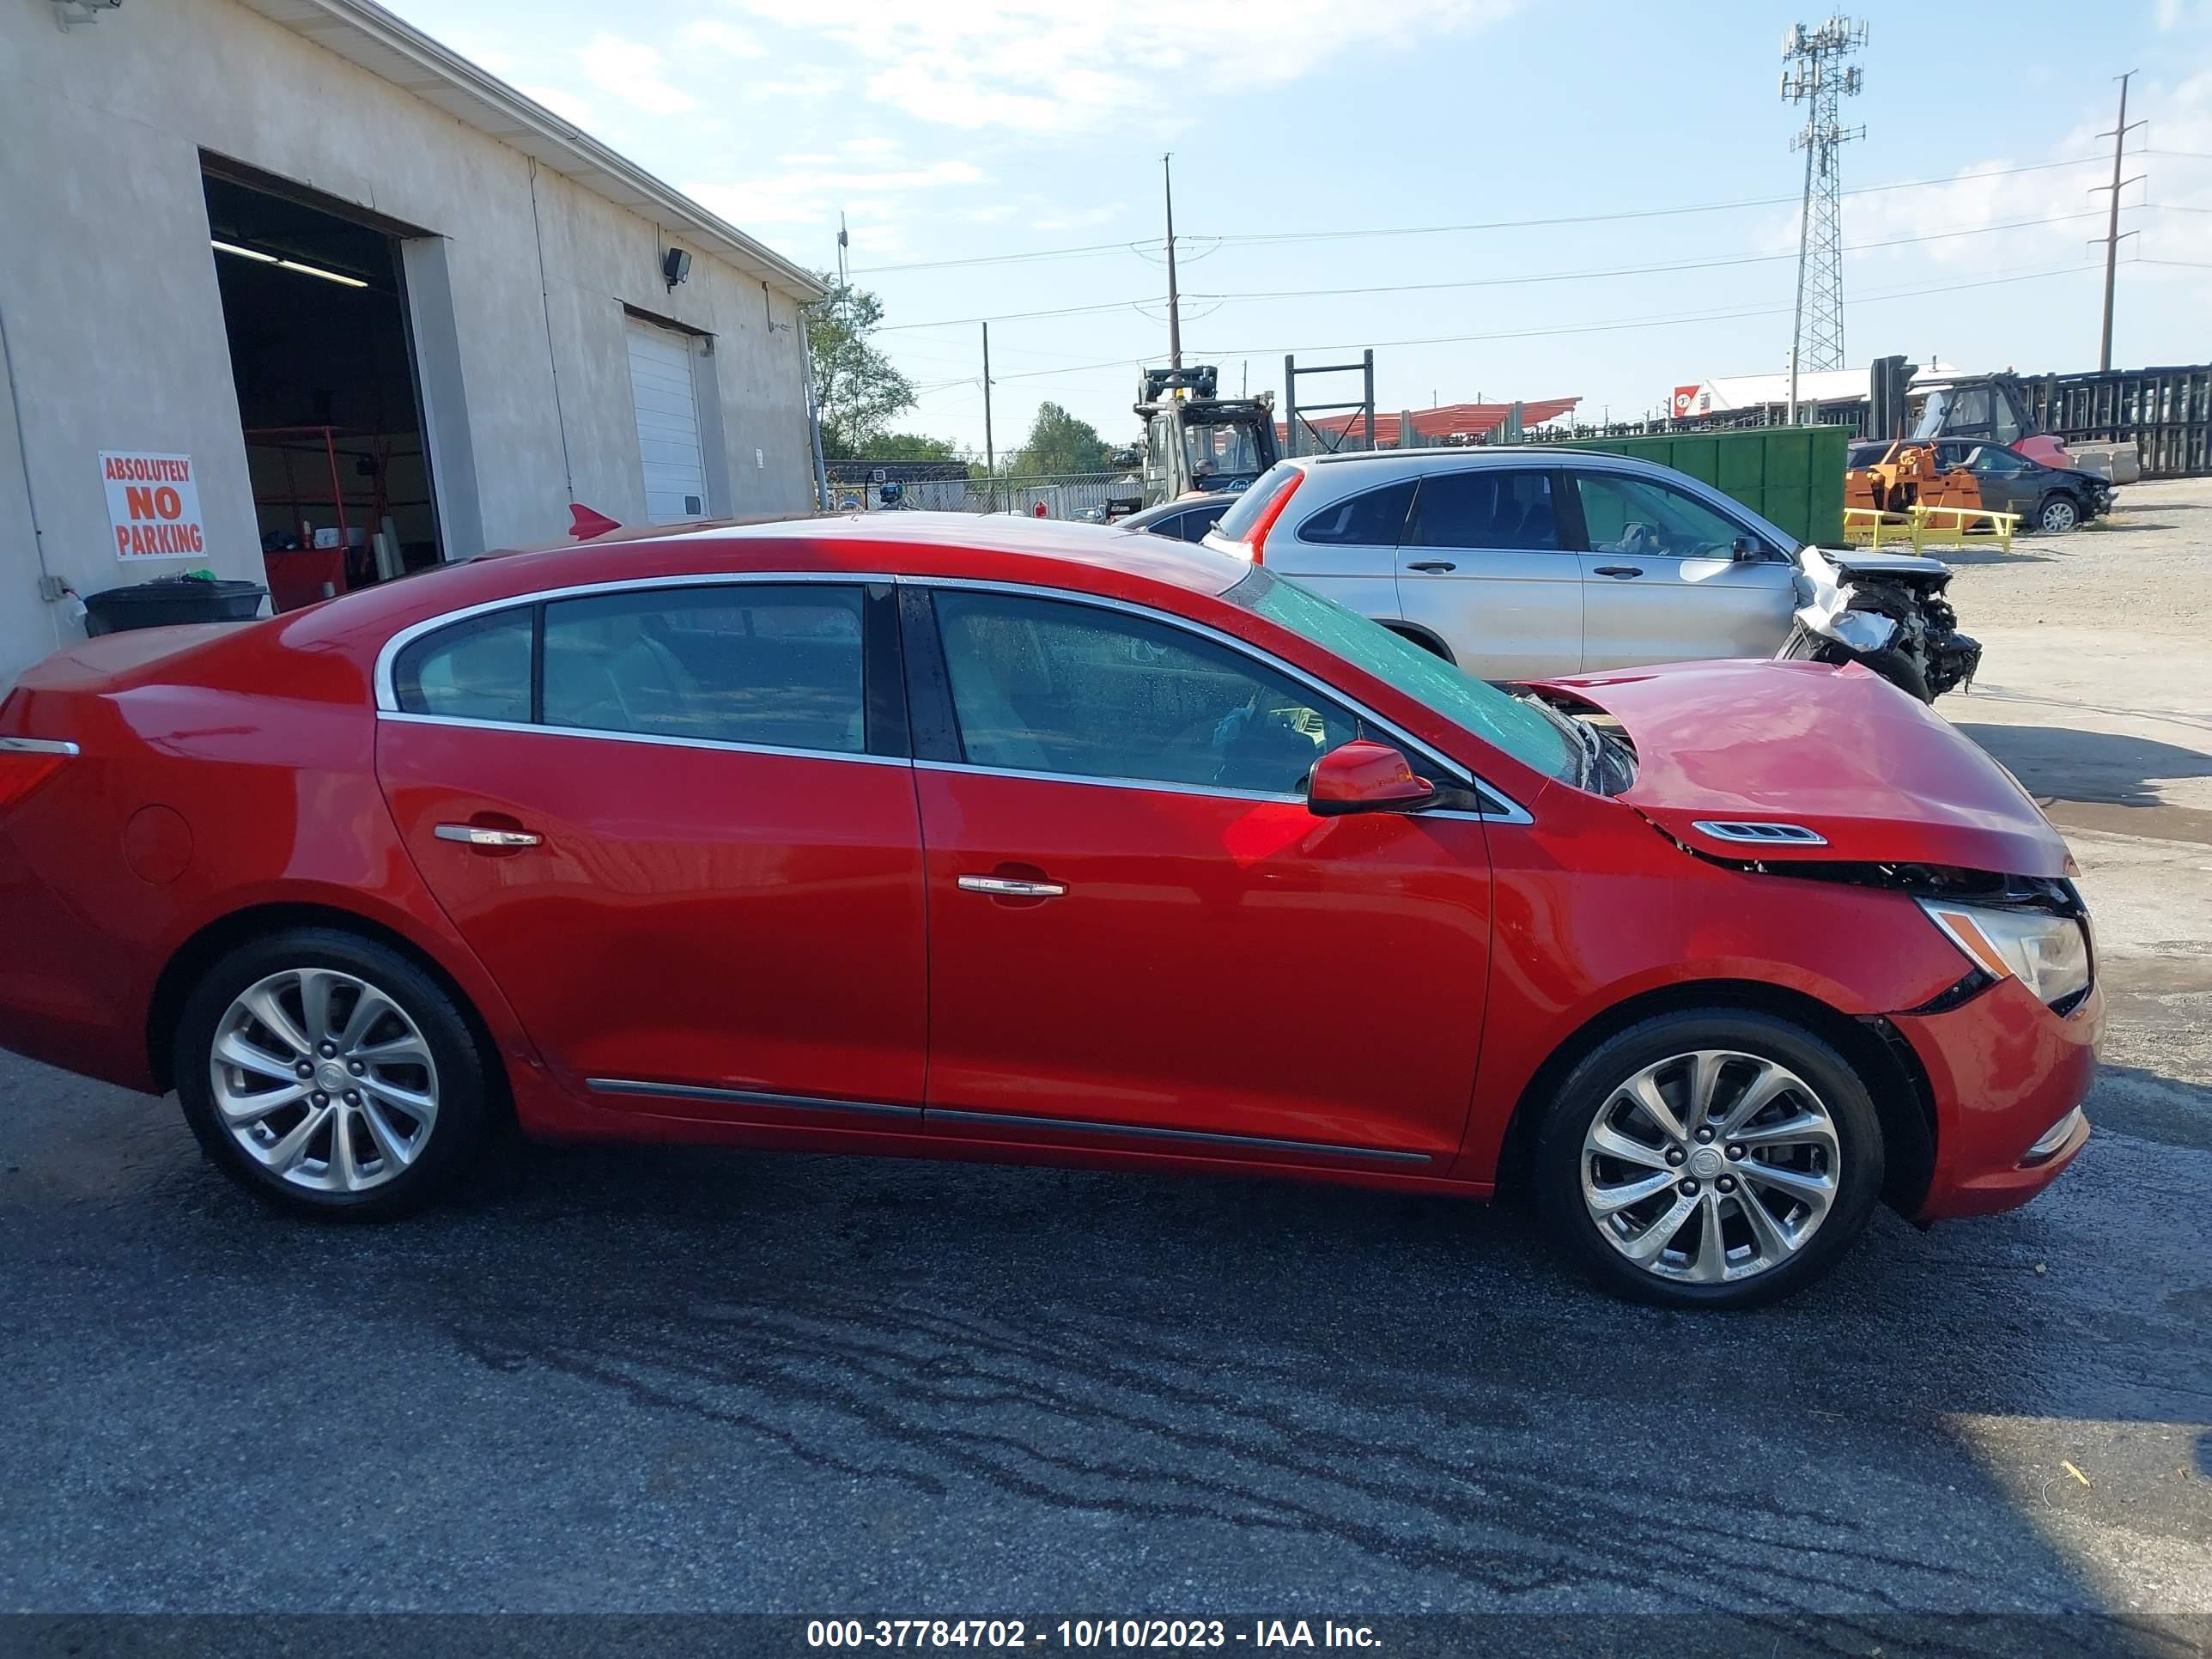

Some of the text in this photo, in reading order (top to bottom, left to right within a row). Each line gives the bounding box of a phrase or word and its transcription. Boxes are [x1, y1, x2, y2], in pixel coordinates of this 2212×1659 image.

[106, 457, 190, 482] ABSOLUTELY
[125, 486, 182, 520] NO
[115, 523, 203, 556] PARKING
